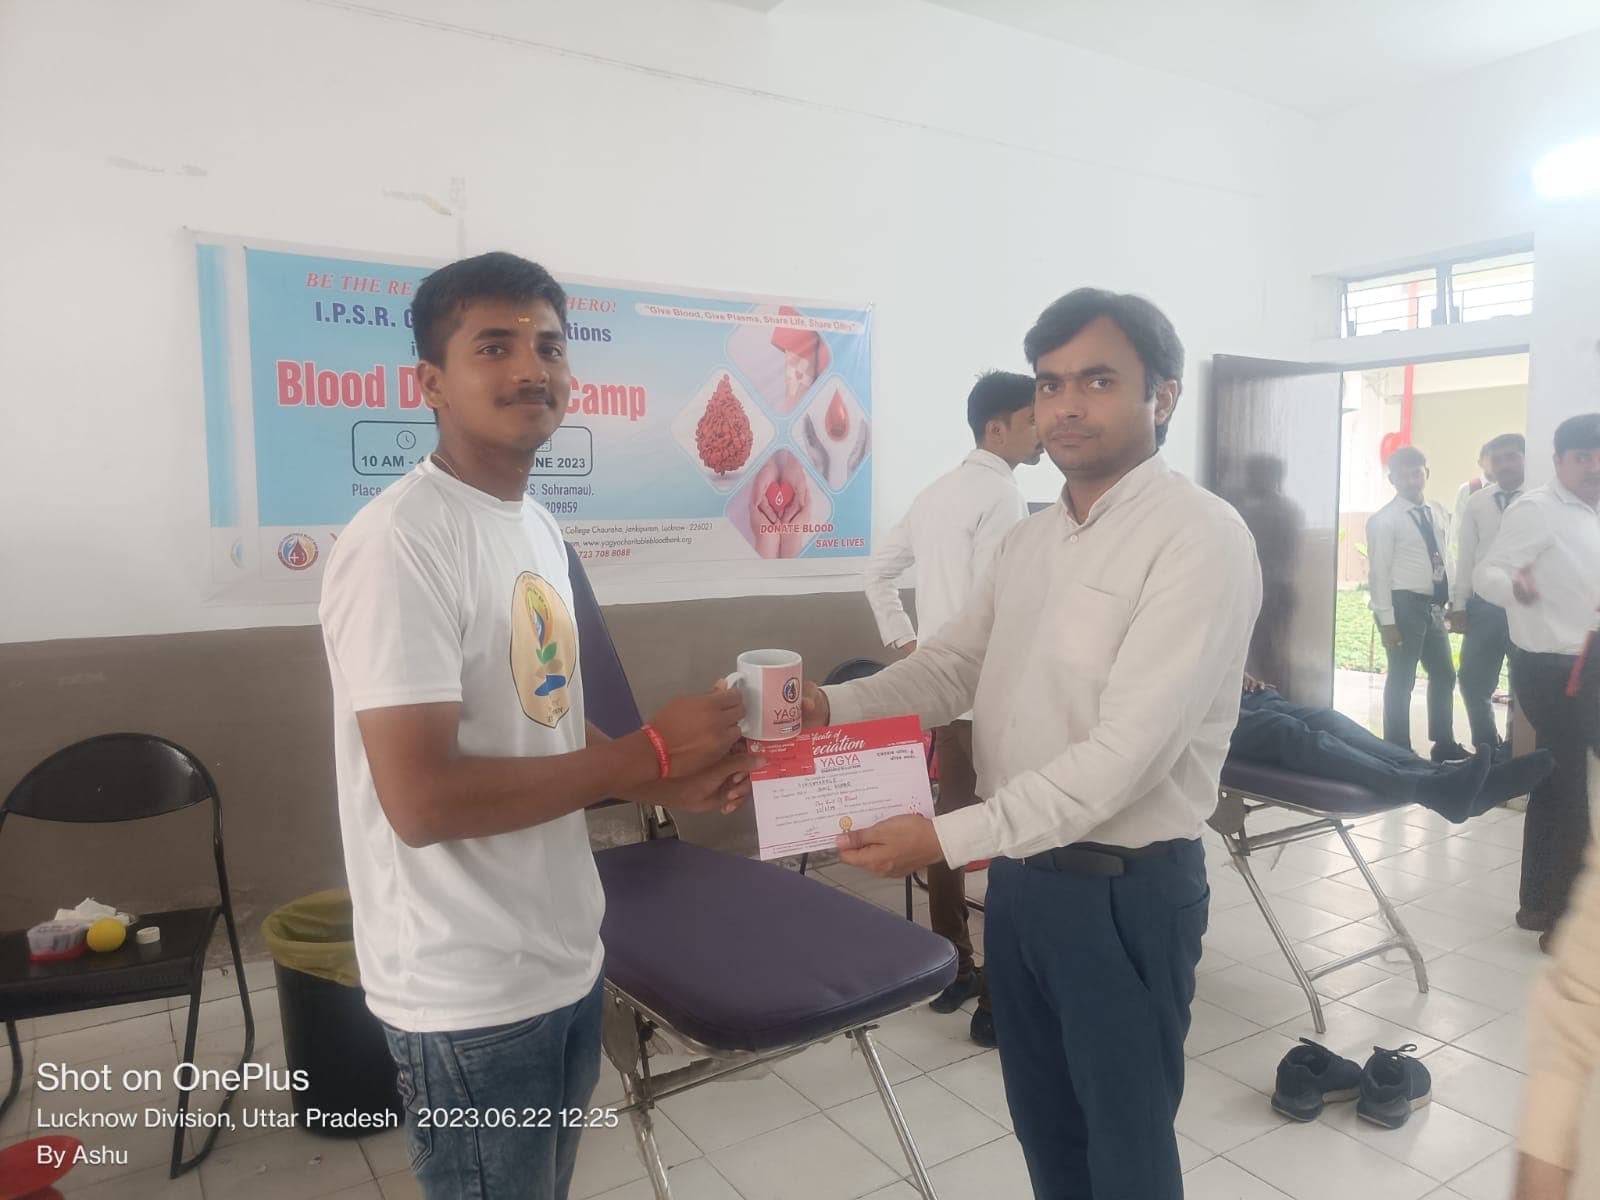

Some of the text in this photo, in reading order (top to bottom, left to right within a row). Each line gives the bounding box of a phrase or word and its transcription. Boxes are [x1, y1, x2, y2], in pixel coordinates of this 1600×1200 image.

[306, 273, 415, 296] BE THE RE
[315, 301, 396, 327] I.P.S.R.
[566, 322, 612, 342] tions
[276, 360, 386, 408] Blood
[361, 455, 378, 467] 10
[381, 455, 404, 467] AM
[535, 457, 586, 469] NE 2023
[351, 483, 382, 496] Place
[565, 525, 591, 535] College
[760, 523, 834, 533] DONATE BLOOD
[815, 538, 865, 548] SAVE LIVES
[812, 735, 866, 755] eciation
[820, 754, 860, 768] YAGYA
